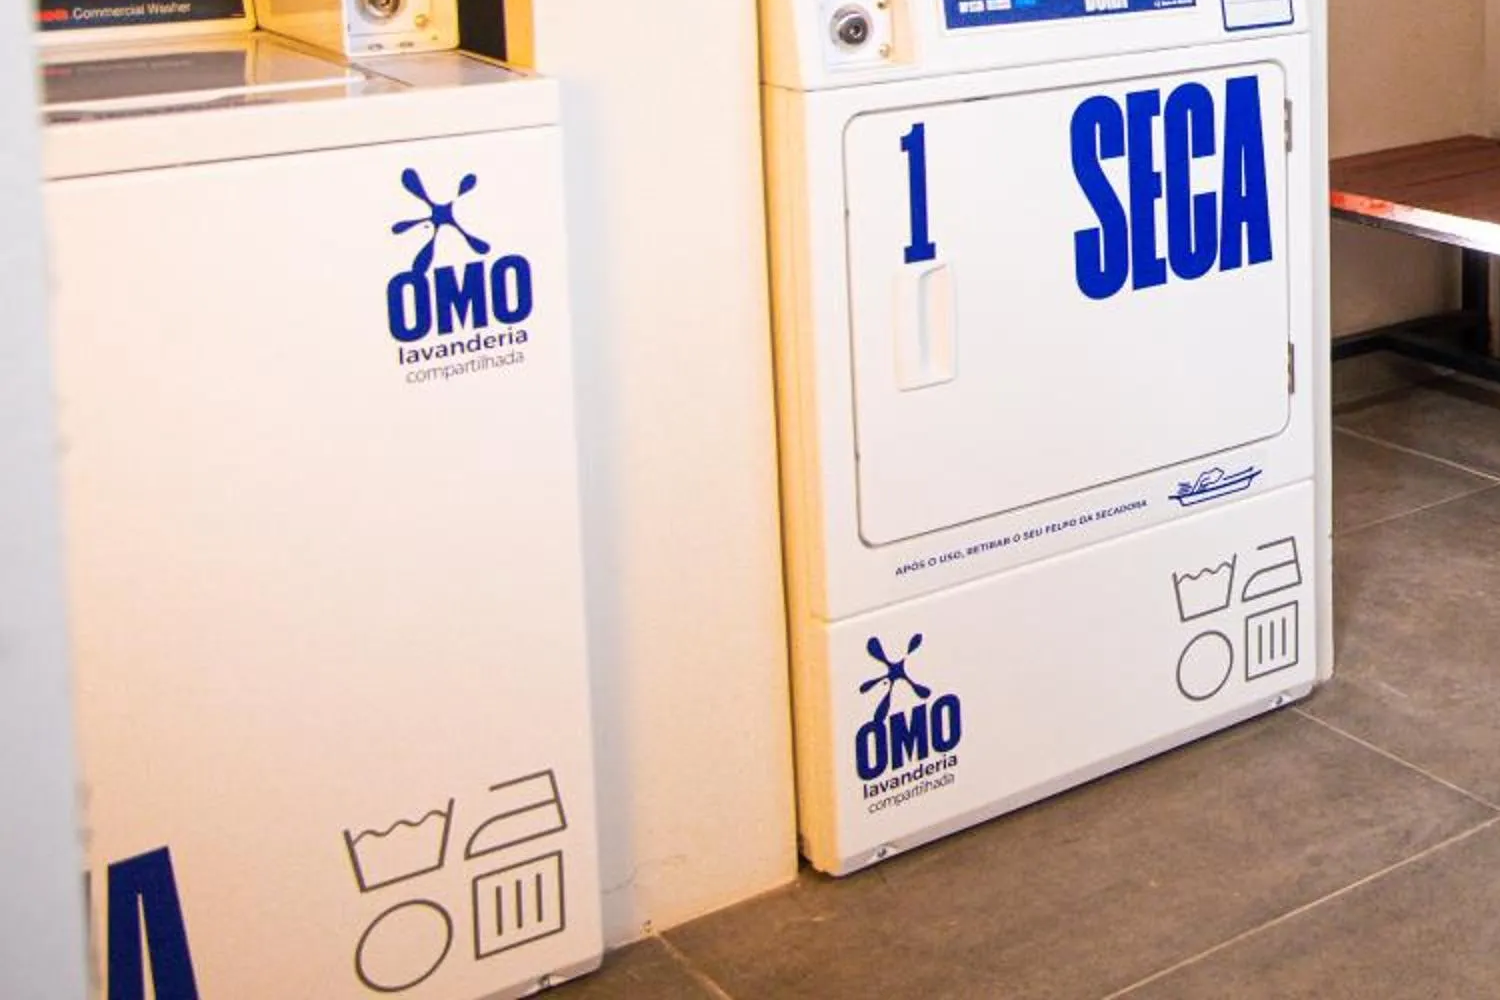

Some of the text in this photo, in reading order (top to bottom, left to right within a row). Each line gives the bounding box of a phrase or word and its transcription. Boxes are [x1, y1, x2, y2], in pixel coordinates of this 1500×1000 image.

[72, 3, 145, 19] Commercial
[147, 2, 191, 14] Washer
[900, 123, 936, 264] 1
[1070, 75, 1273, 300] SECA
[386, 254, 533, 342] OMO
[398, 327, 528, 365] lavanderia
[405, 350, 525, 384] compartilhada
[928, 557, 937, 567] O
[1012, 533, 1021, 543] O
[1023, 527, 1043, 540] SEU
[1079, 514, 1093, 525] DA
[855, 694, 962, 780] OMO
[863, 753, 958, 800] lavanderia
[867, 773, 955, 814] compartilhada
